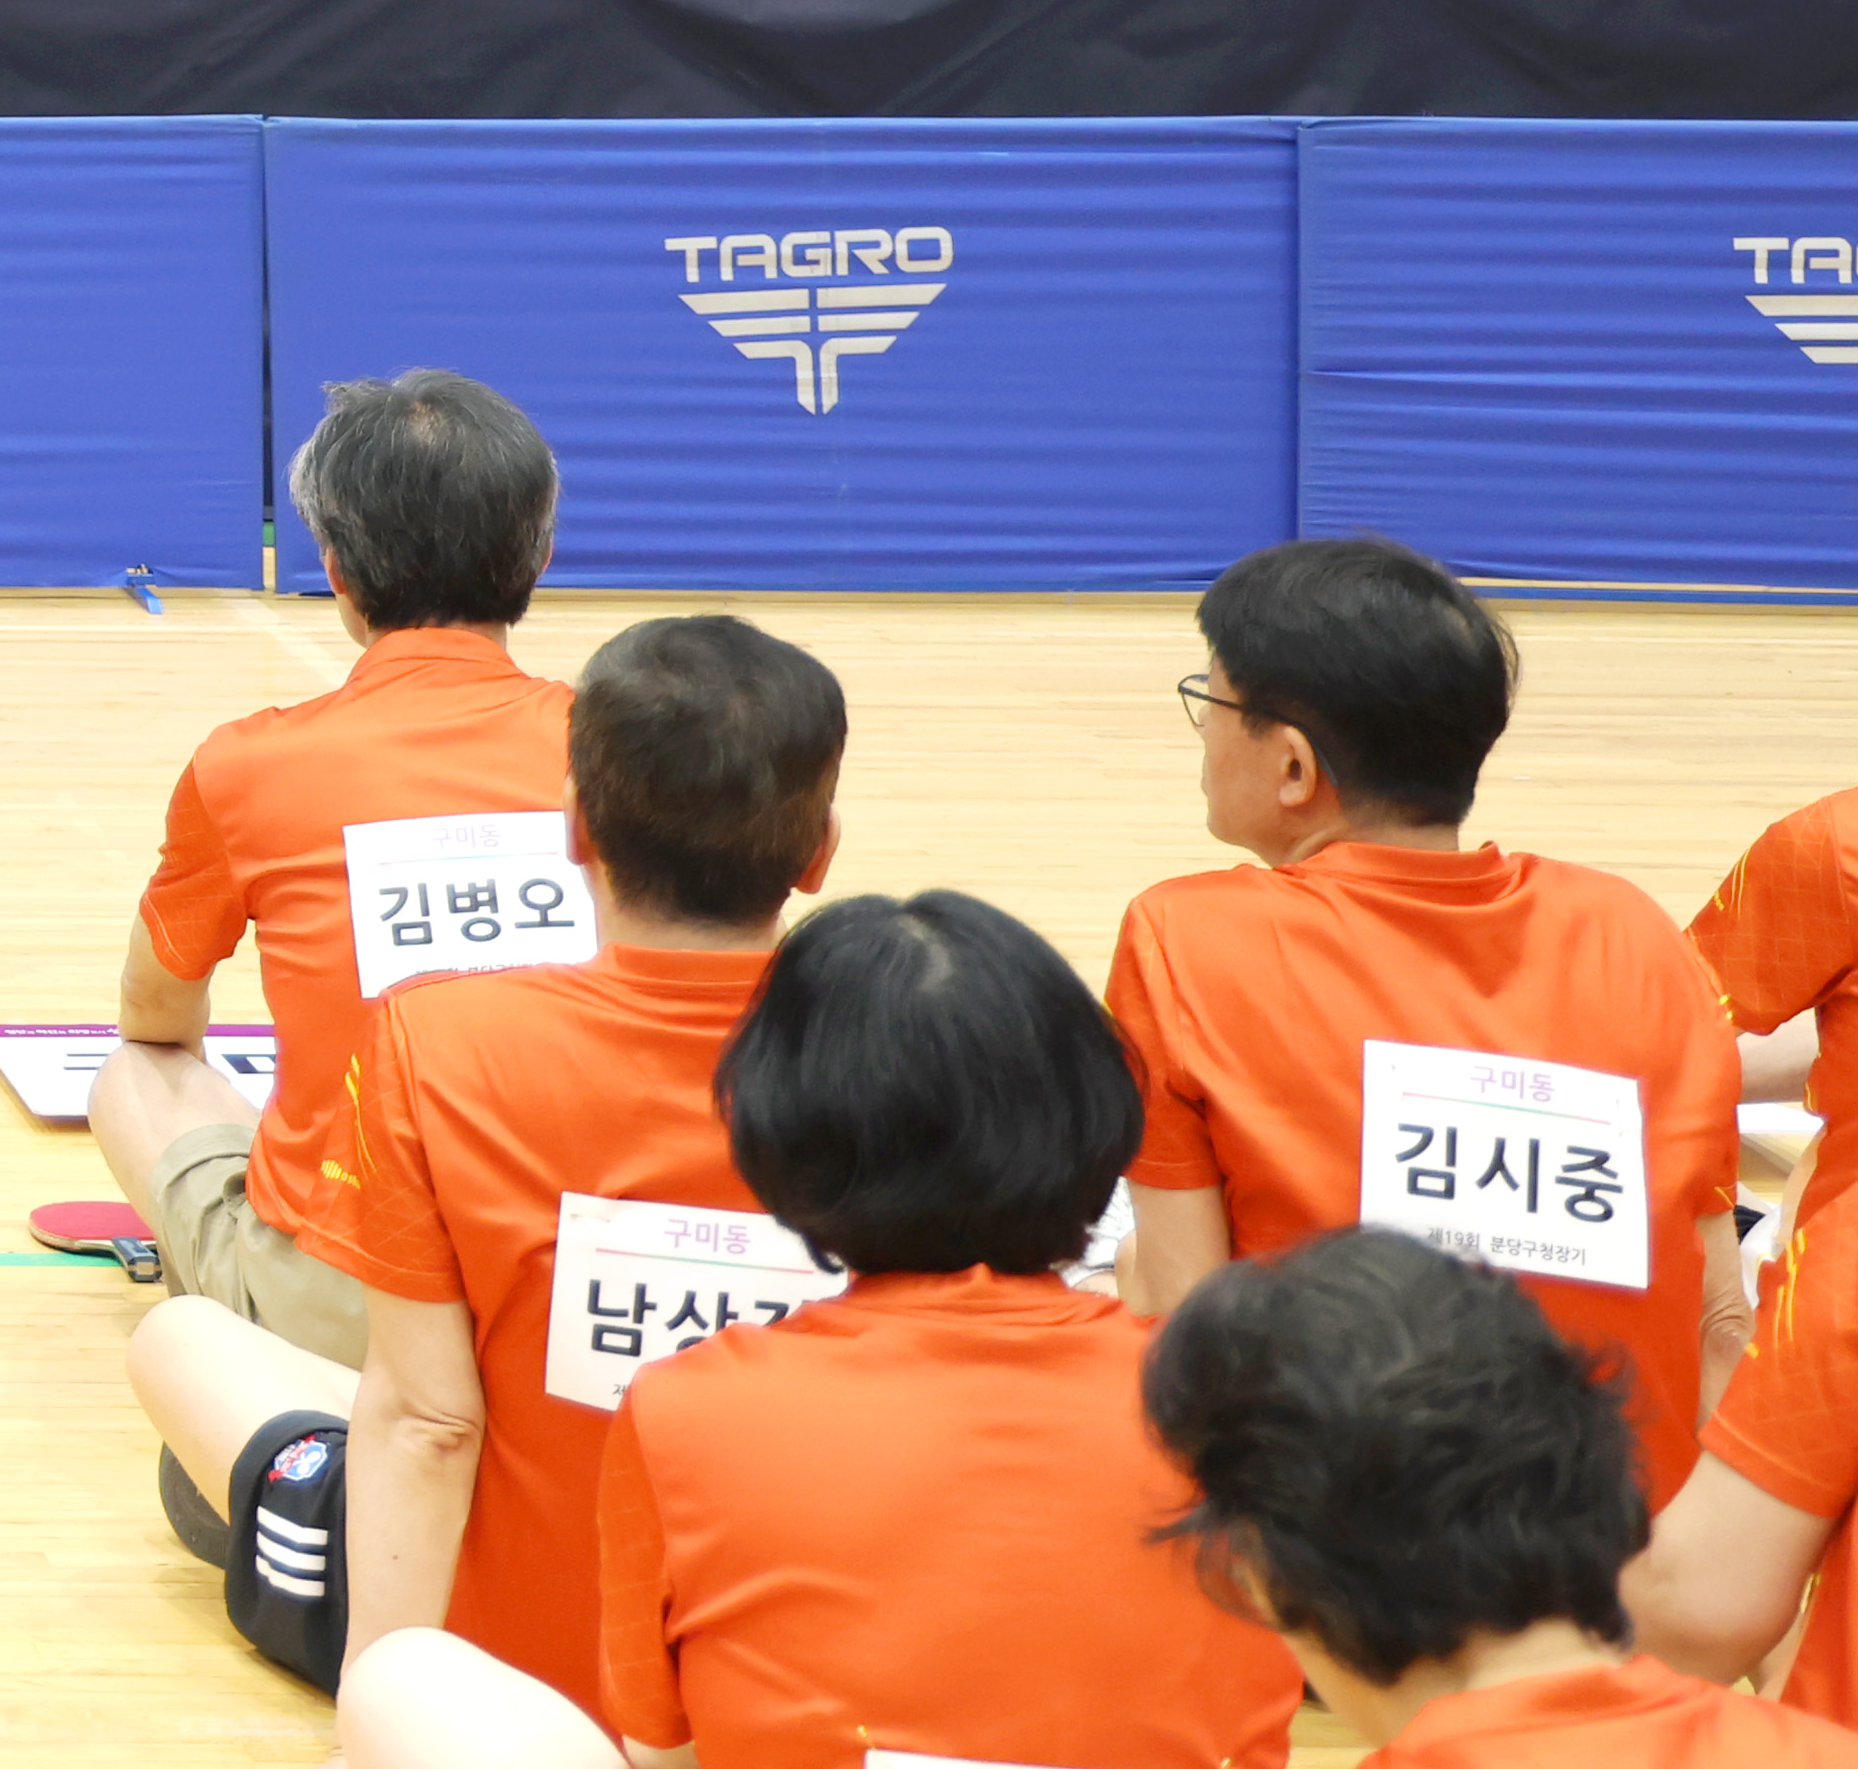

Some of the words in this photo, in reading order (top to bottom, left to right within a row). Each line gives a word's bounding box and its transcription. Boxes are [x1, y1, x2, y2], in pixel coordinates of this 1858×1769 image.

[665, 225, 955, 283] TAGRO
[1733, 235, 1858, 285] TA
[431, 824, 502, 850] 구미동
[378, 877, 576, 948] 김병오
[1469, 1065, 1556, 1104] 구미동
[1394, 1122, 1625, 1224] 김시중
[663, 1217, 752, 1255] 구미동
[1427, 1226, 1481, 1251] 제19회
[1489, 1235, 1587, 1267] 분당구청장기
